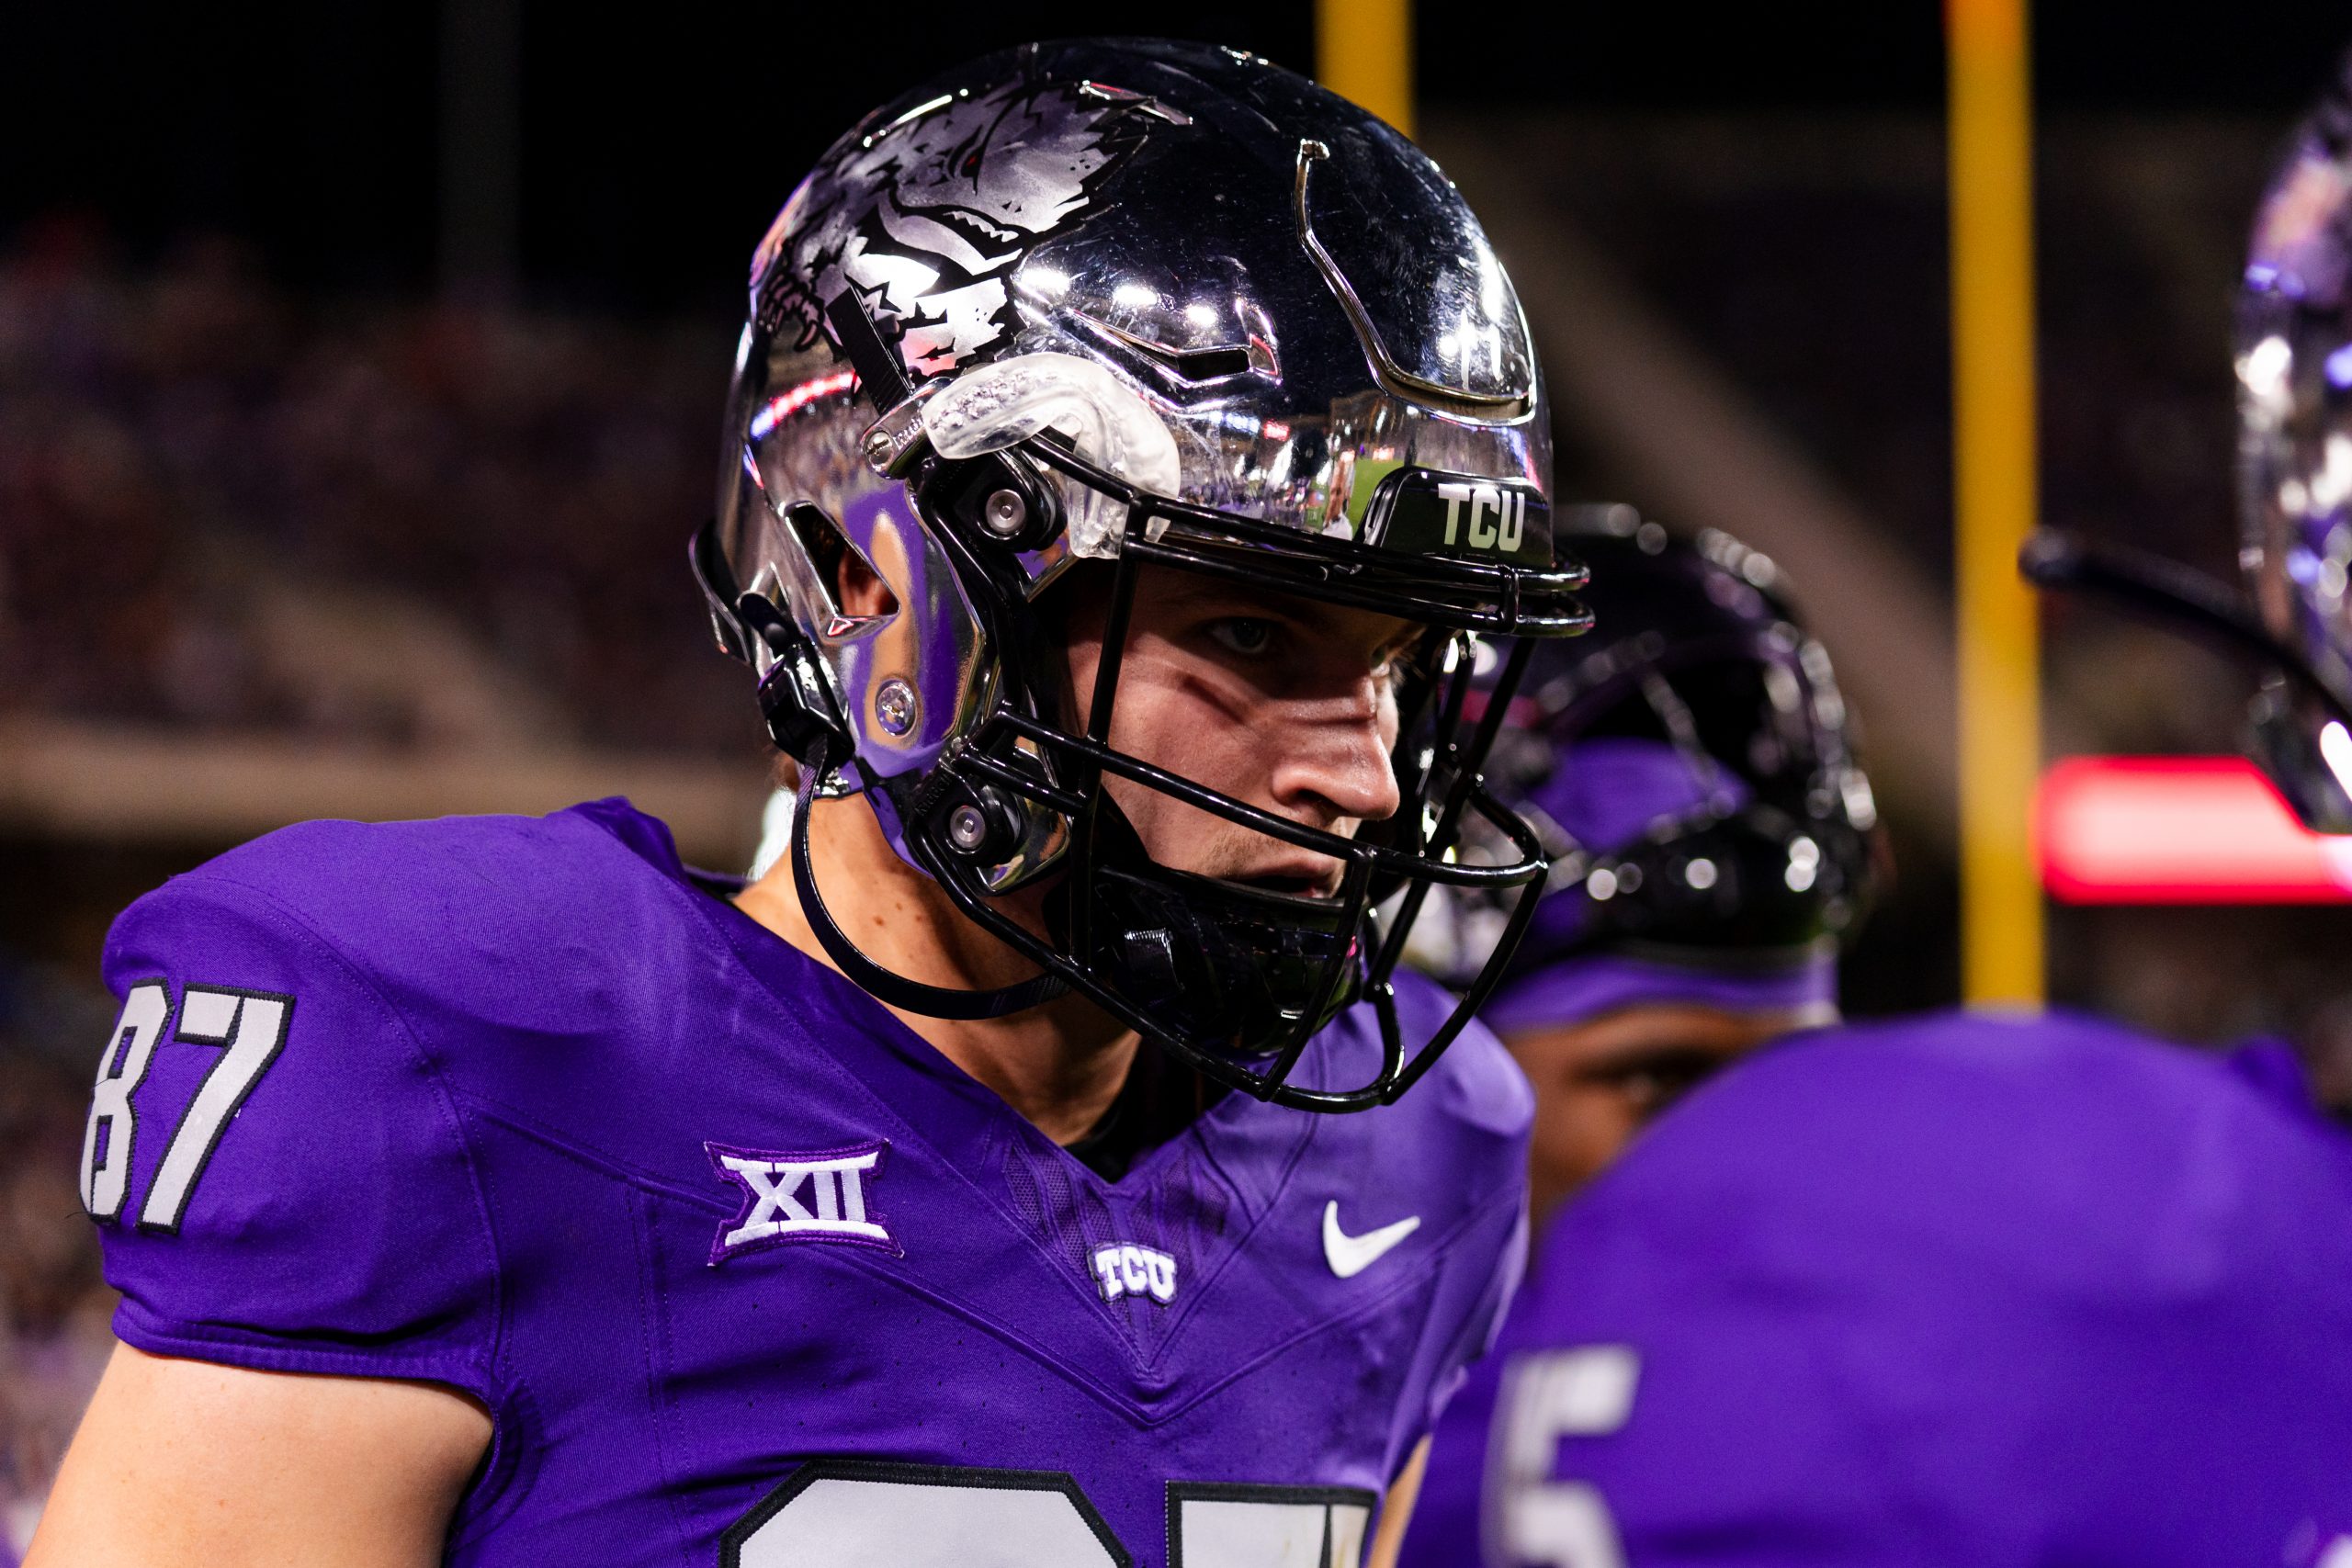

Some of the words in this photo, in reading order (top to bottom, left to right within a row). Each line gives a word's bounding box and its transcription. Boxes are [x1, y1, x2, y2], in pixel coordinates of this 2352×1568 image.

[1438, 483, 1525, 552] TCU
[80, 976, 296, 1235] 87
[720, 1151, 889, 1247] XII
[1094, 1246, 1176, 1301] TCU
